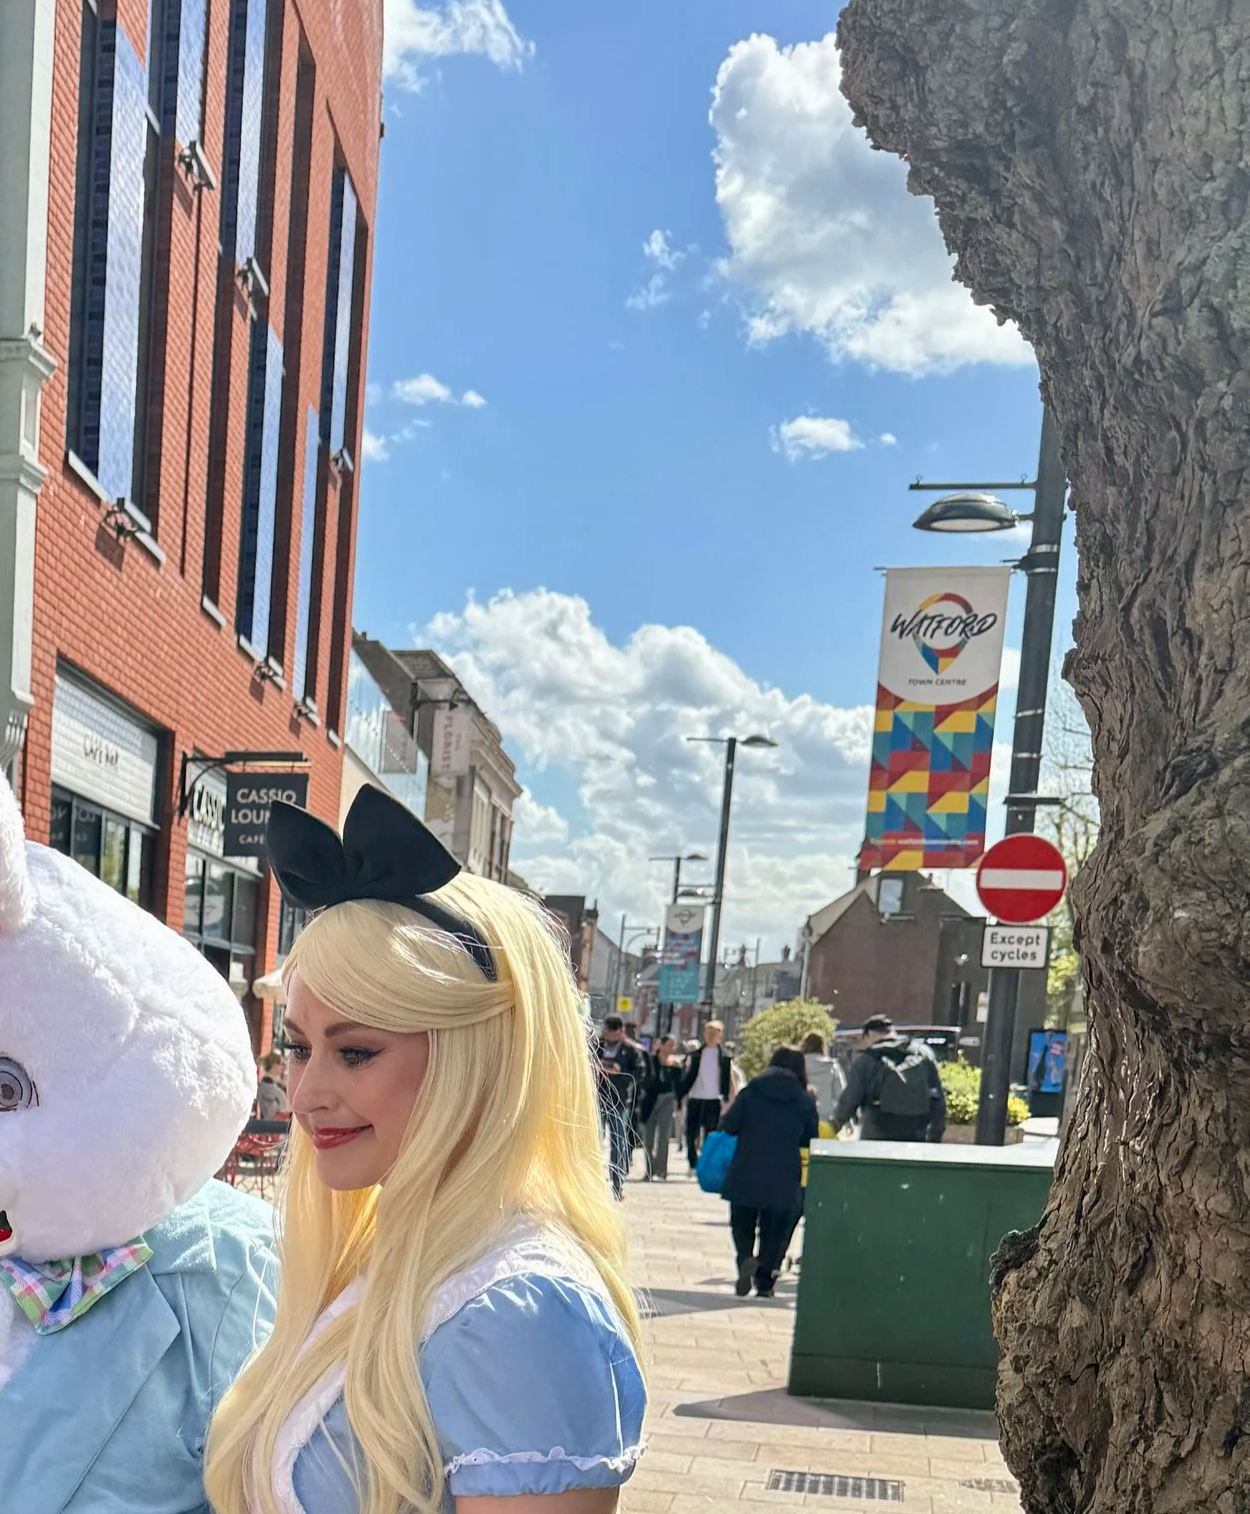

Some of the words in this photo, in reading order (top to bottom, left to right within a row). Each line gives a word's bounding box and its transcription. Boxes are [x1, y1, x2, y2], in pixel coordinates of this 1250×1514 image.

[890, 611, 998, 641] WATFORD
[908, 678, 933, 686] TOWN
[935, 678, 967, 687] CENTRE
[236, 788, 297, 804] CASSIO
[990, 932, 1040, 948] Except
[990, 947, 1037, 964] cycles
